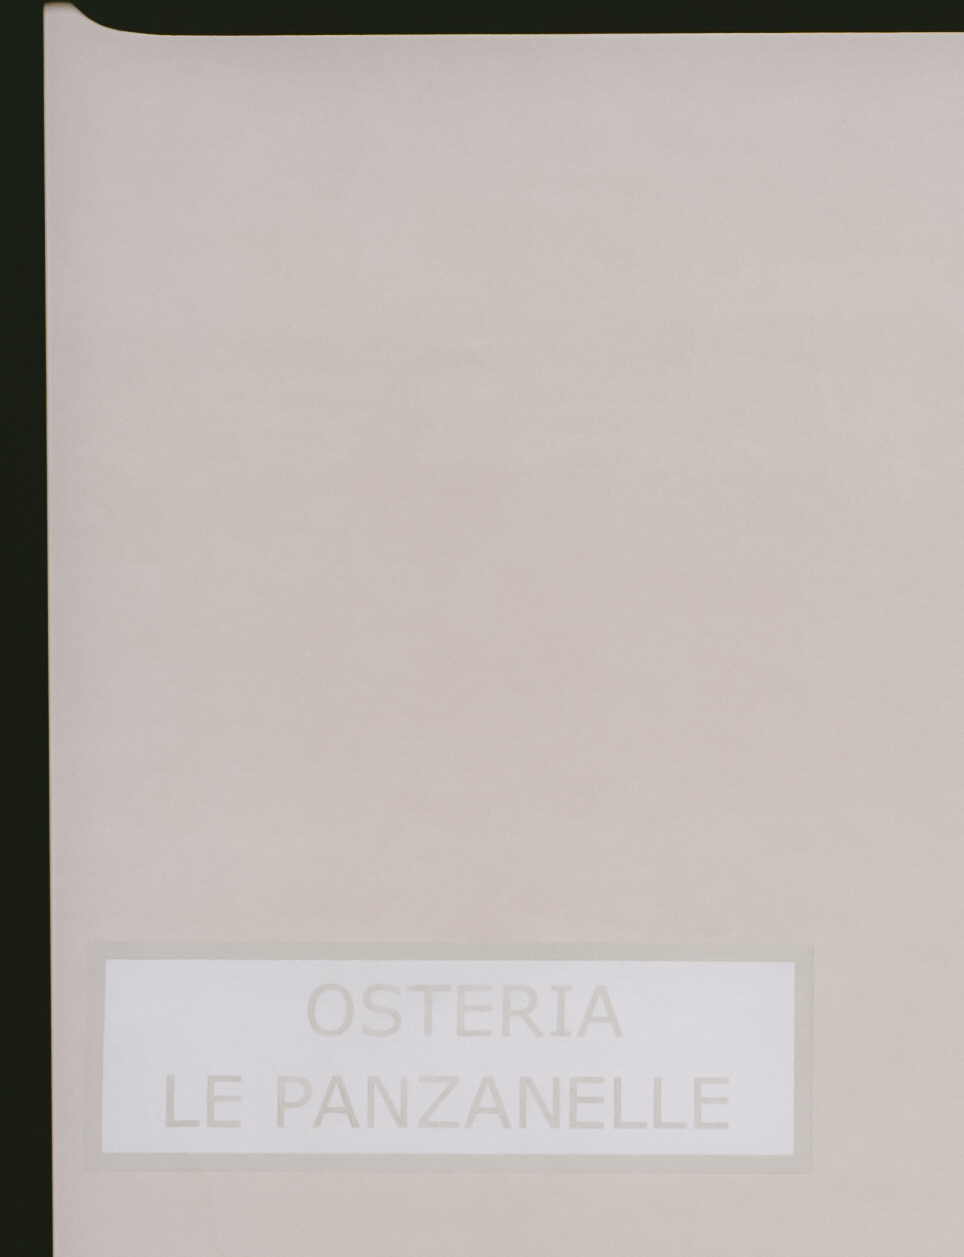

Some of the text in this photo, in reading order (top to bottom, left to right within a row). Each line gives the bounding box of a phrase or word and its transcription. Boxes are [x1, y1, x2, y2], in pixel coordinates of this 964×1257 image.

[305, 982, 625, 1038] OSTERIA
[164, 1074, 731, 1131] LE PANZANELLE
